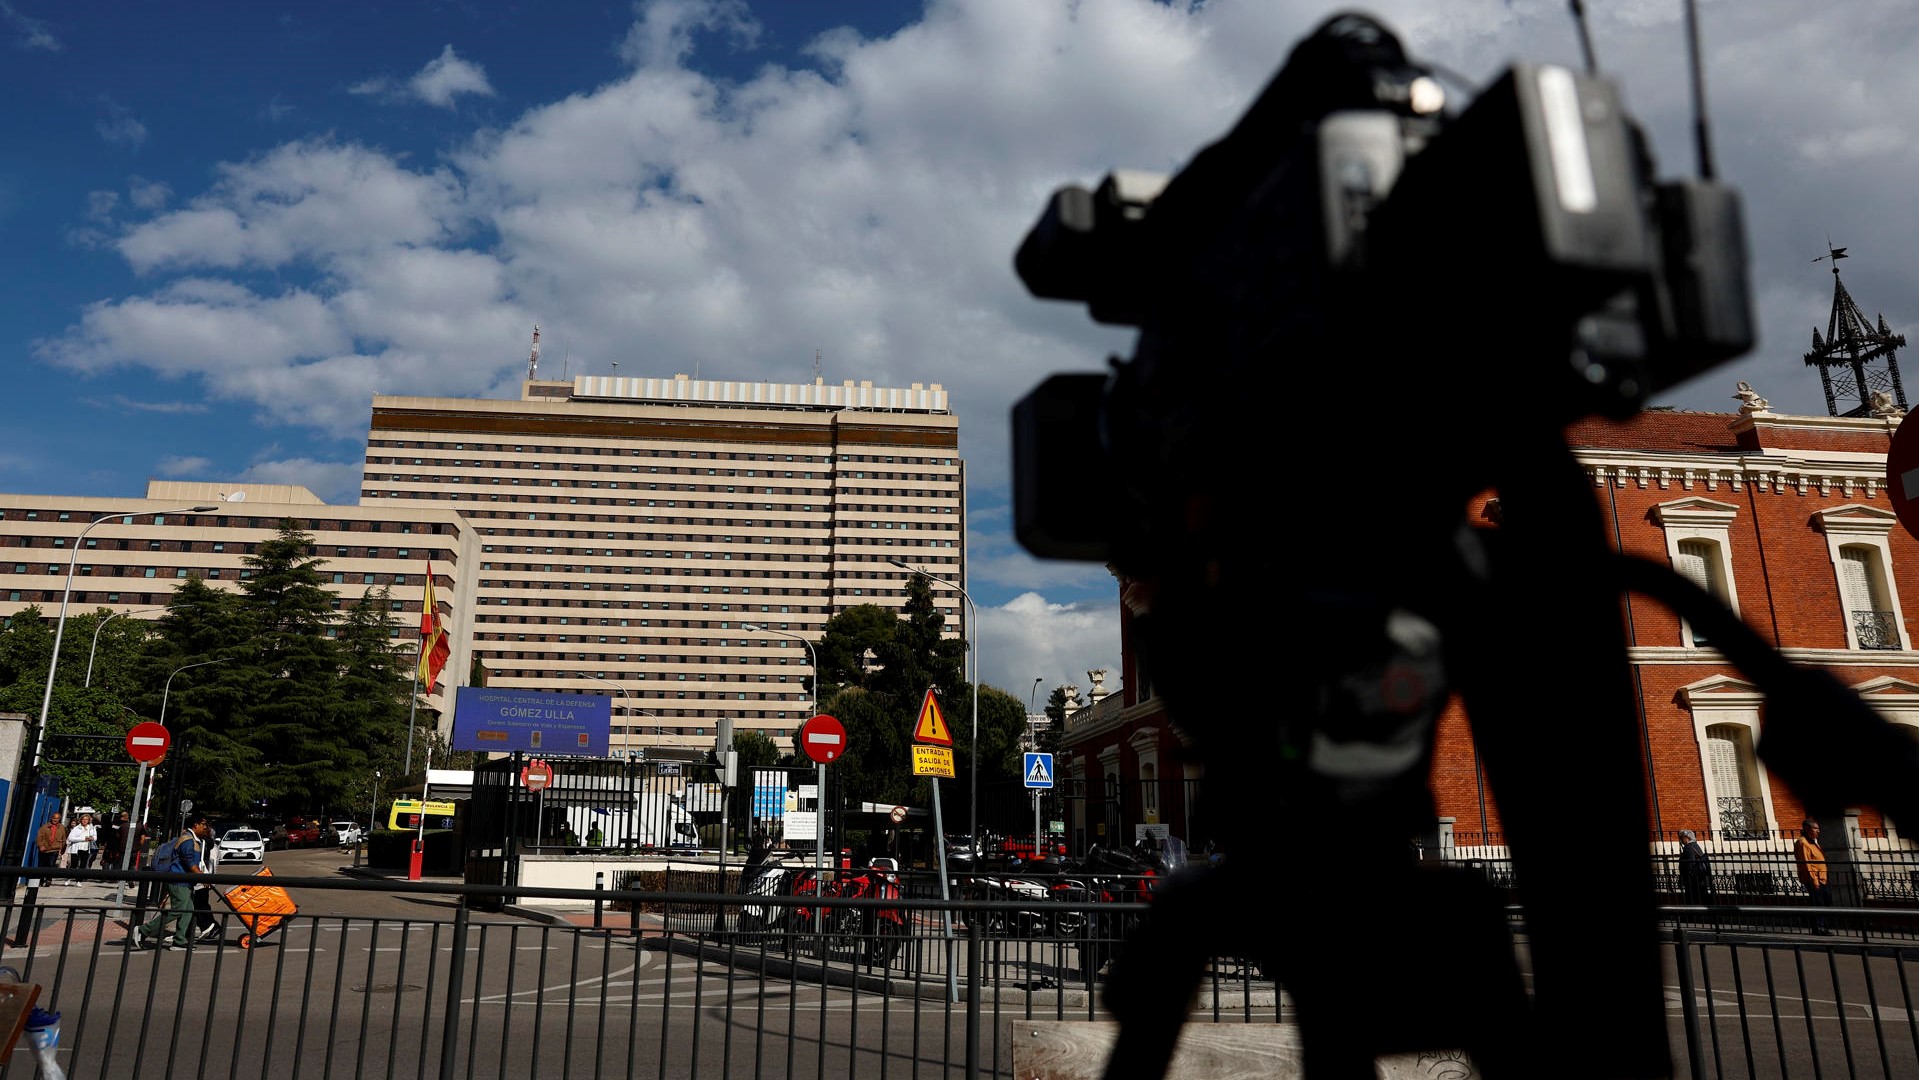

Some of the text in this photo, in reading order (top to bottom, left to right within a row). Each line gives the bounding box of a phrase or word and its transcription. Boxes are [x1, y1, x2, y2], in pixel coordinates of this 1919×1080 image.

[480, 695, 512, 703] HOSPITAL
[513, 697, 545, 705] CENTRAL
[565, 700, 596, 708] DEFENSA
[500, 705, 575, 720] GÓMEZ ULLA
[916, 747, 945, 756] ENTRADA
[918, 757, 942, 765] SALIDA
[919, 766, 951, 775] CAMIONES
